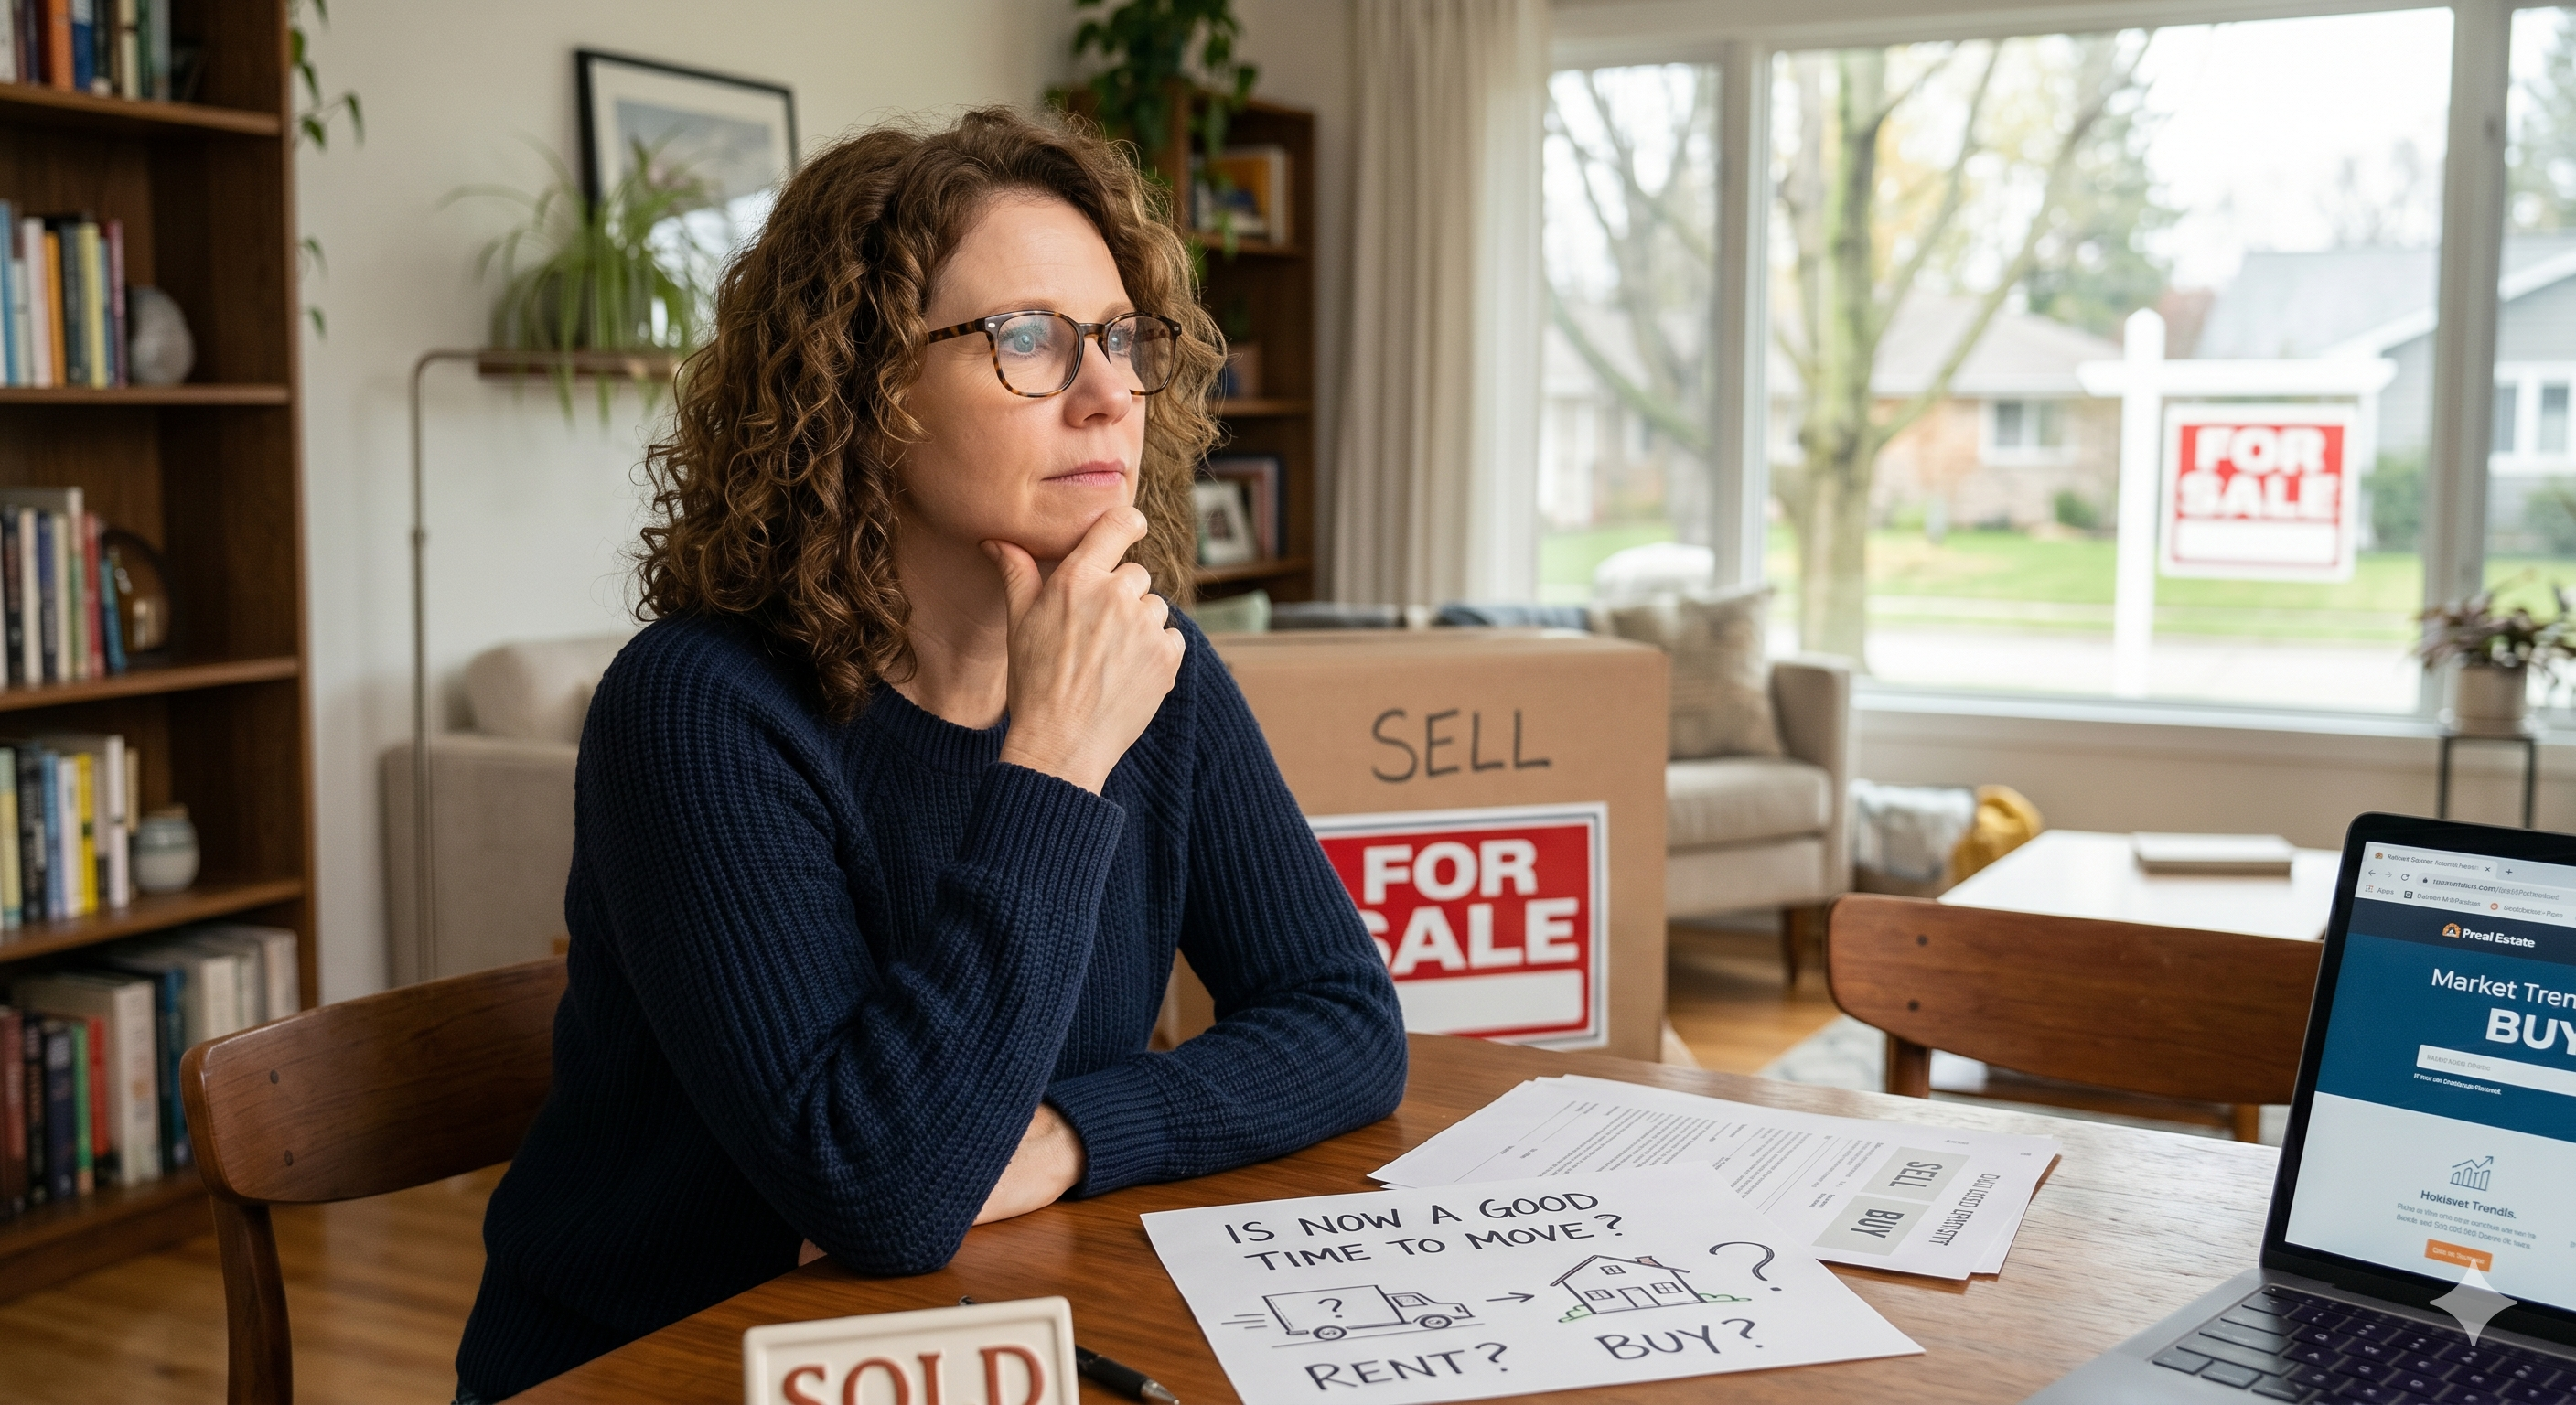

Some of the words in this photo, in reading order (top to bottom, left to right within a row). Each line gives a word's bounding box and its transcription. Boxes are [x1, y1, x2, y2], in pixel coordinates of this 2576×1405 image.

[2195, 426, 2326, 476] FOR
[2179, 471, 2338, 519] SALE
[1372, 708, 1551, 784] SELL
[1363, 839, 1538, 905] FOR
[2462, 928, 2494, 942] Preal
[2495, 932, 2536, 949] Estate
[2431, 968, 2517, 1000] Market
[1888, 1161, 1943, 1187] SELL
[1224, 1221, 1275, 1244] IS
[1298, 1208, 1402, 1236] NOW
[1431, 1204, 1463, 1224] A
[1478, 1193, 1599, 1219] GOOD
[1243, 1243, 1372, 1271] TIME
[1385, 1238, 1446, 1255] TO
[1464, 1214, 1623, 1250] MOVE?
[1851, 1208, 1905, 1239] BUY
[1709, 1241, 1783, 1292] ?
[1317, 1297, 1343, 1319] ?
[1594, 1318, 1764, 1360] BUY?
[1304, 1342, 1508, 1391] RENT?
